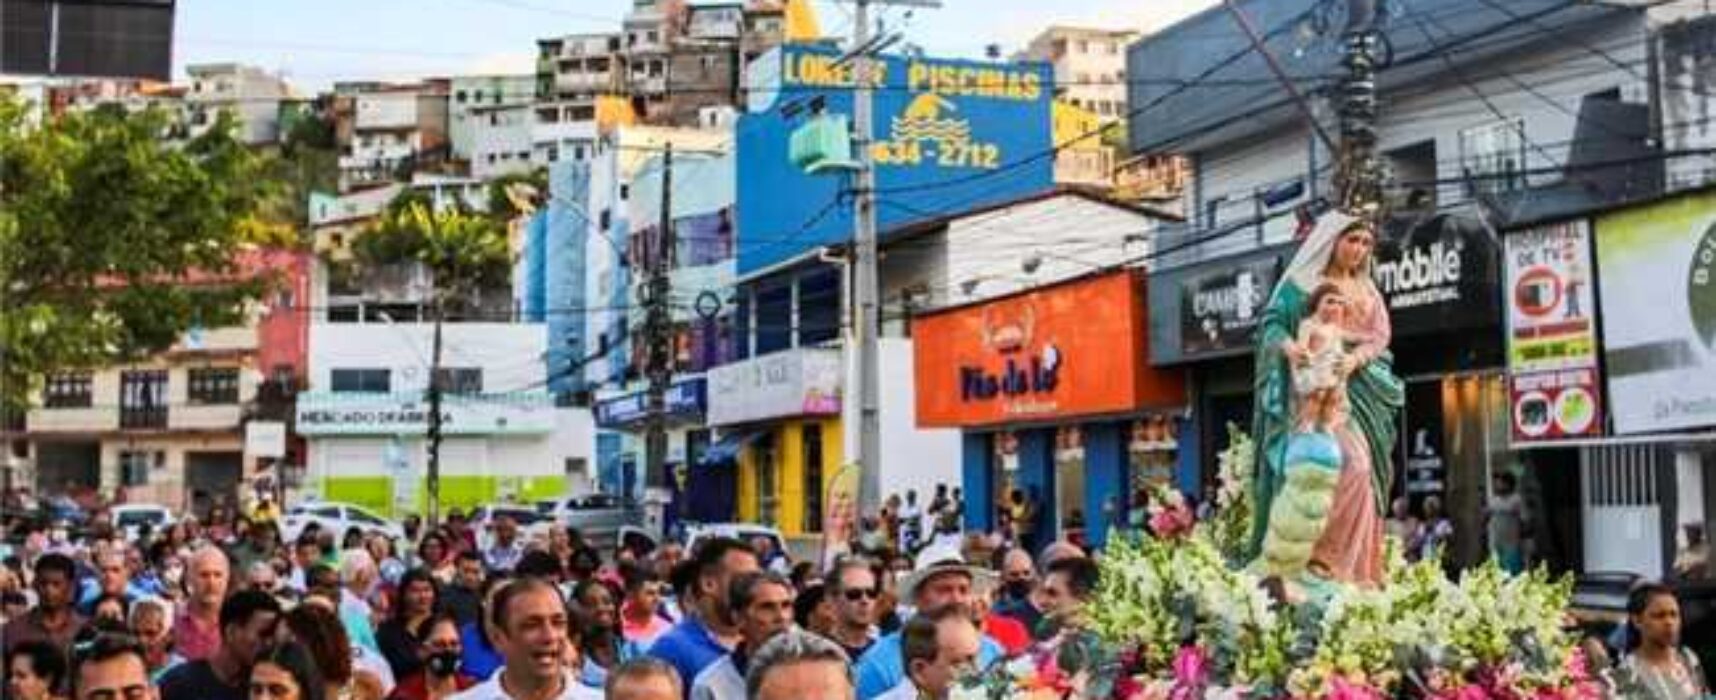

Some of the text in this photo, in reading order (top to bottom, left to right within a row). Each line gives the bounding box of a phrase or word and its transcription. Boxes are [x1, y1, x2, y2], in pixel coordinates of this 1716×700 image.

[908, 63, 1041, 99] PISCINAS
[867, 140, 998, 170] 634-2712
[1193, 284, 1261, 317] CAMPS
[301, 410, 375, 425] MERCADO
